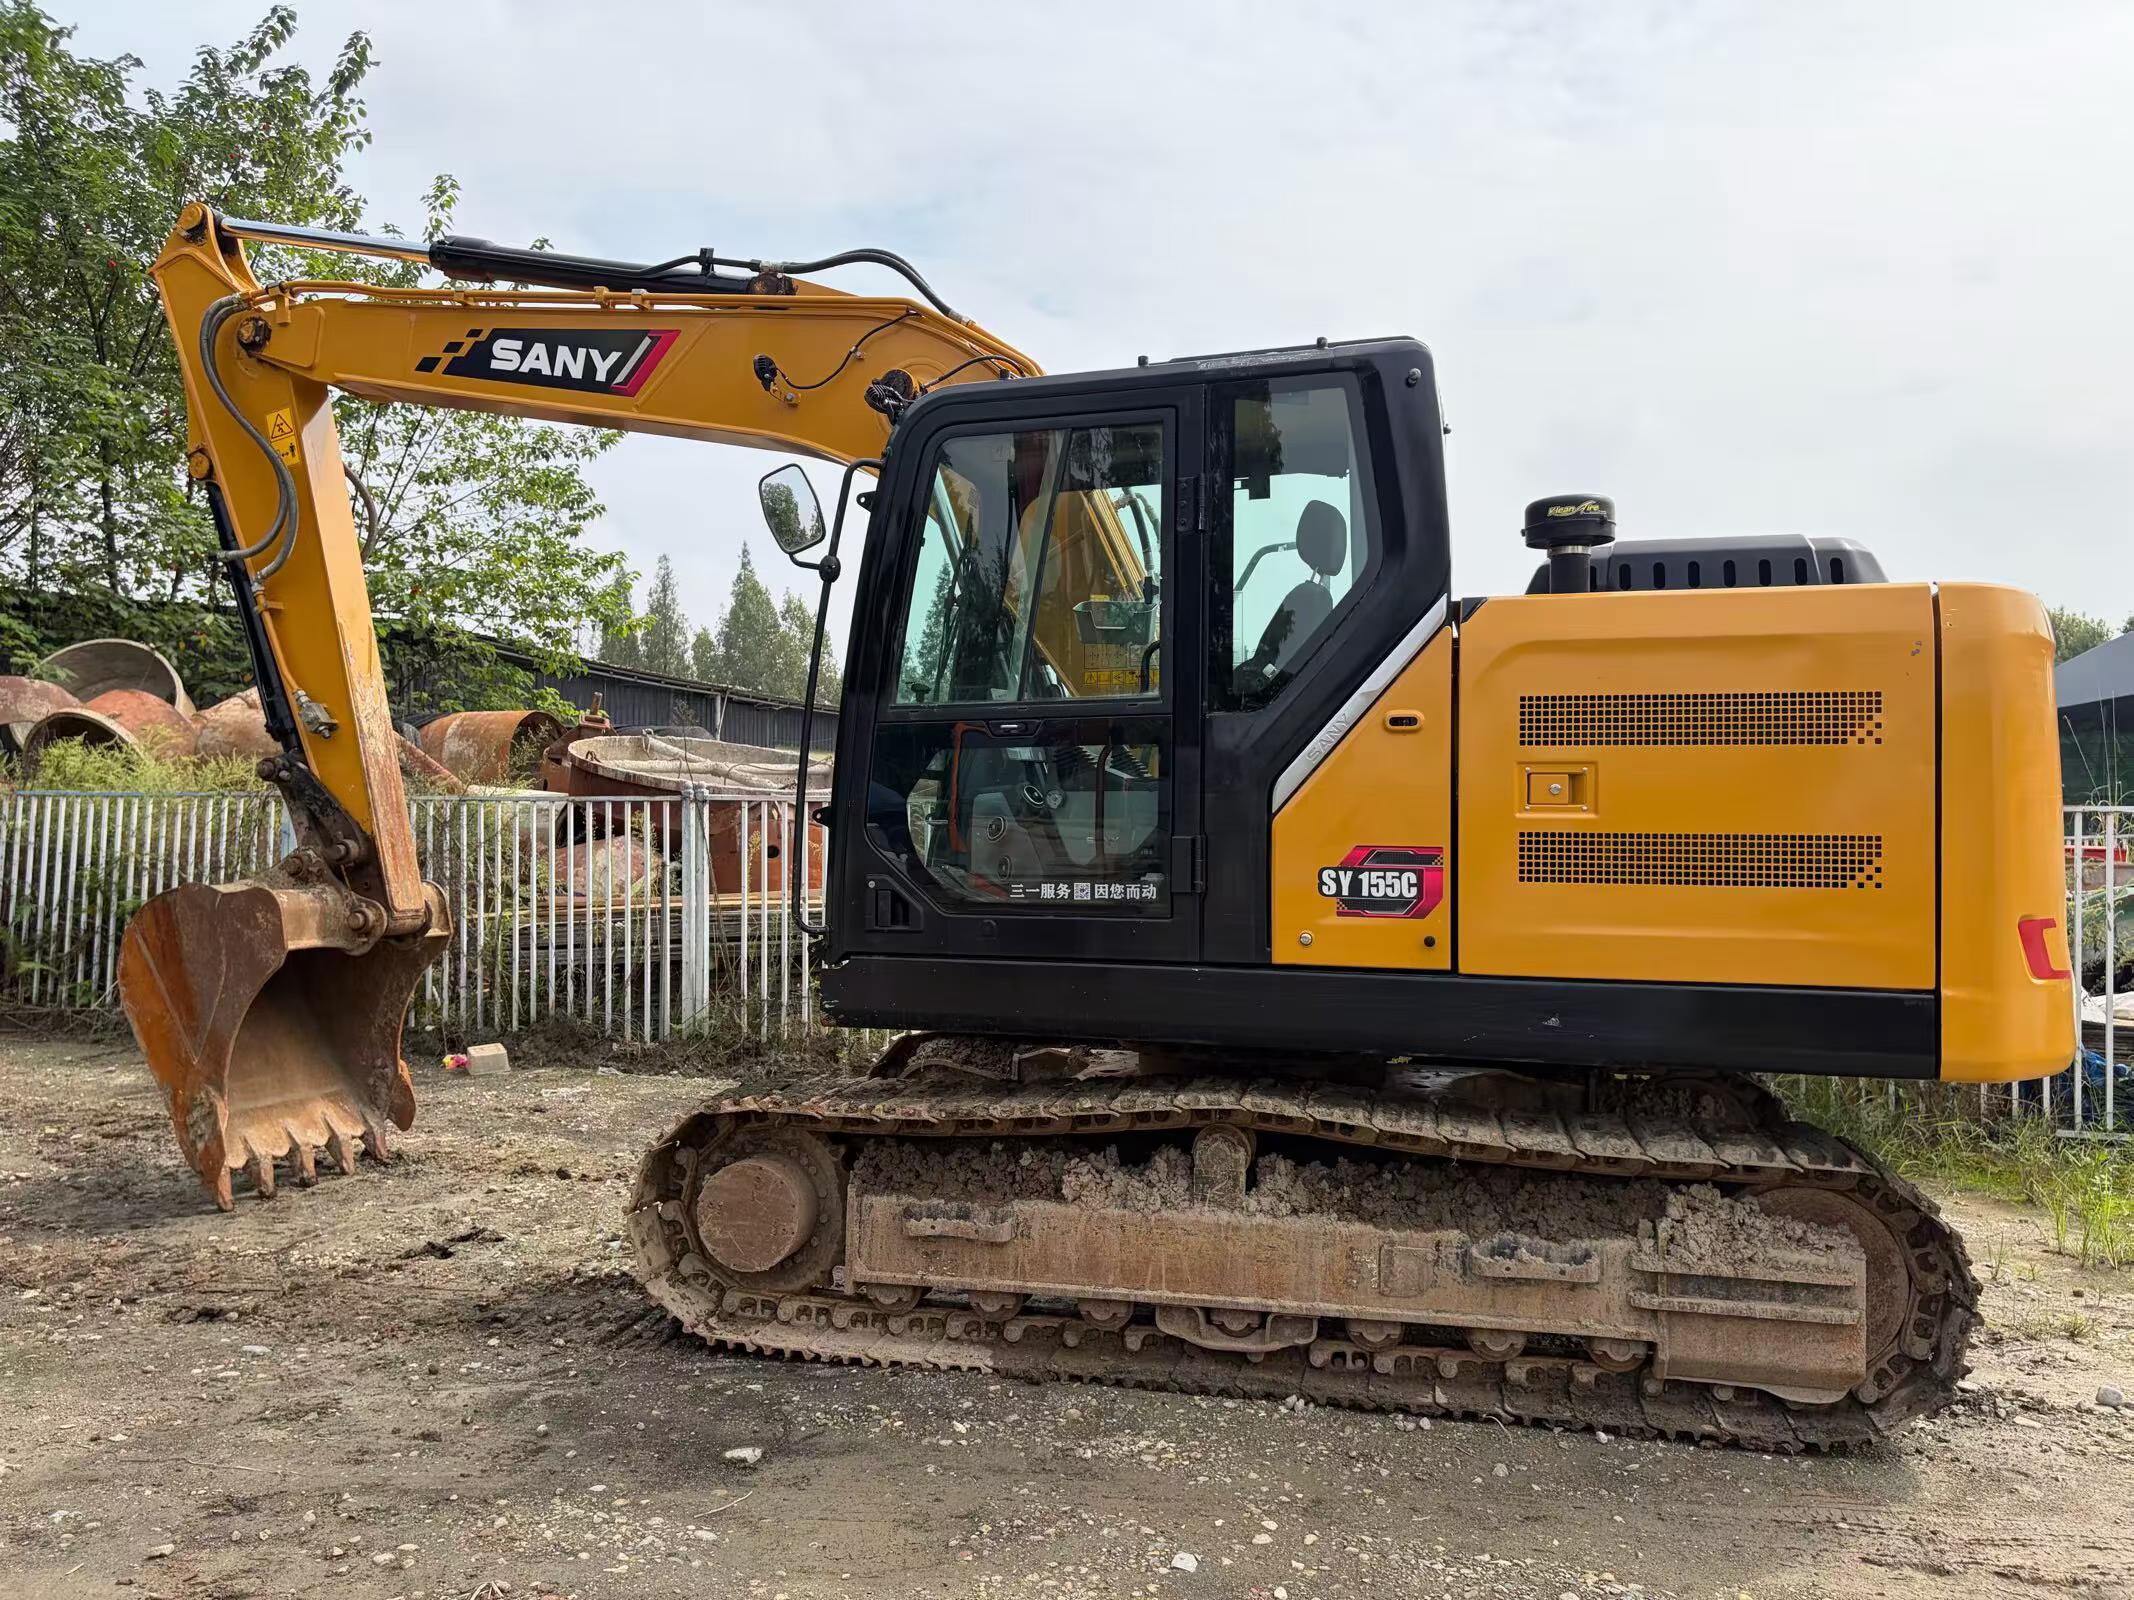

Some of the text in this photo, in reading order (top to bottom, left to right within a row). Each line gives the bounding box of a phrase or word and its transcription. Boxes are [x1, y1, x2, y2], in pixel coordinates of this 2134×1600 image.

[490, 338, 622, 382] SANY
[1306, 713, 1350, 764] SANY
[1010, 883, 1157, 900] 三一服务 因您而动
[1321, 869, 1418, 898] SY 155C
